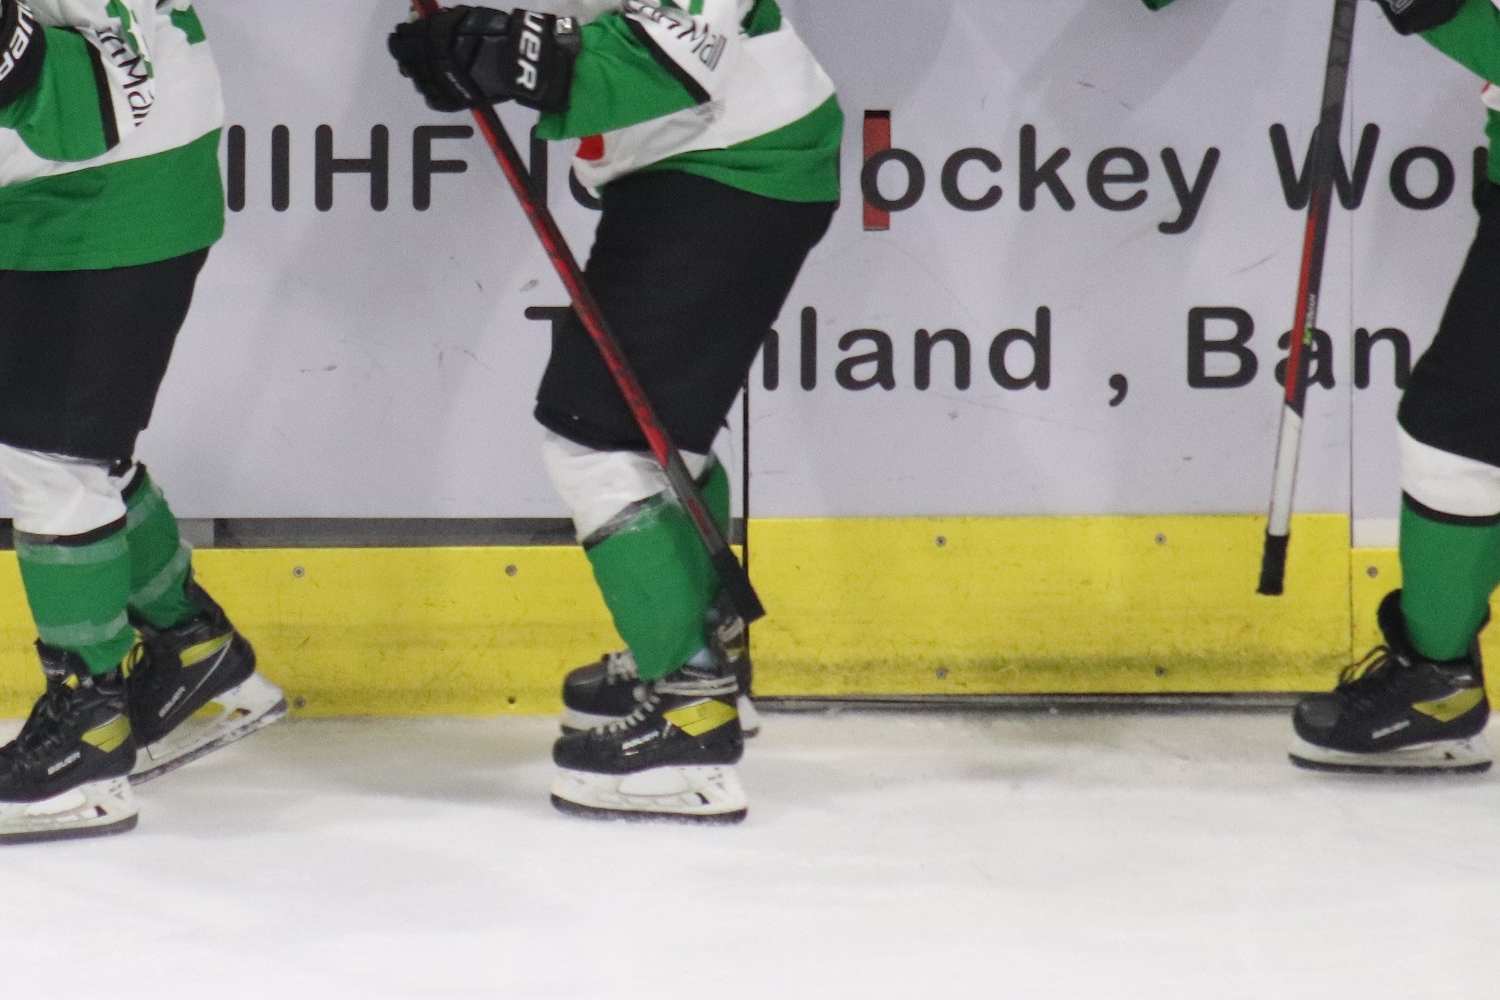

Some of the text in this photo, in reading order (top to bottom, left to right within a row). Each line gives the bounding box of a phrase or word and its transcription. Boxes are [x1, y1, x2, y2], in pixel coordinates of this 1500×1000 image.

[516, 10, 543, 91] UER
[227, 124, 474, 212] IIHF
[861, 124, 1220, 234] ockey
